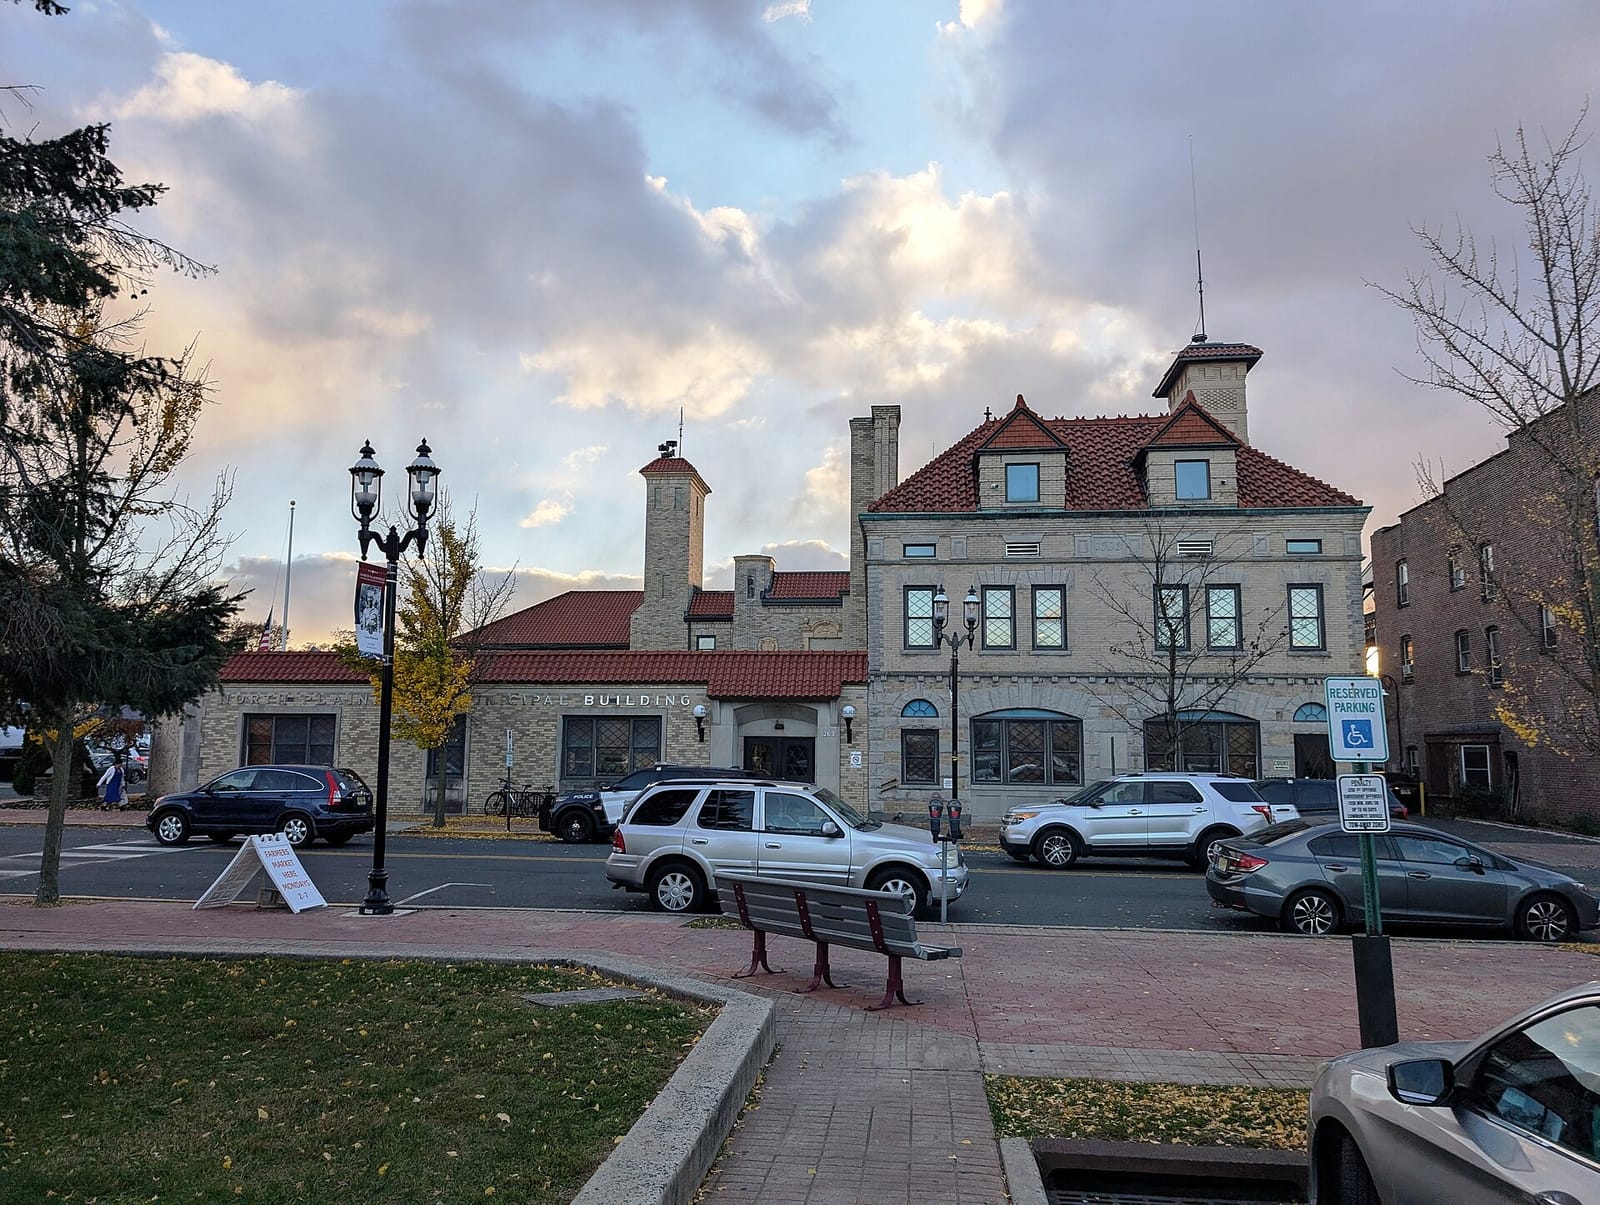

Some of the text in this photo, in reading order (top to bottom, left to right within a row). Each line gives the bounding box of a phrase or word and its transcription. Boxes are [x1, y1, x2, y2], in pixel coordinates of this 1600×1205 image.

[1329, 687, 1378, 699] RESERVED
[220, 693, 691, 706] NORTH PLAIN UNICIPAL BUILDING
[1334, 702, 1376, 713] PARKING
[1350, 779, 1372, 787] PENALTY
[264, 849, 290, 858] FARMERS
[271, 860, 295, 869] MARKET
[281, 870, 299, 879] HERE
[281, 880, 311, 890] MONDAYS
